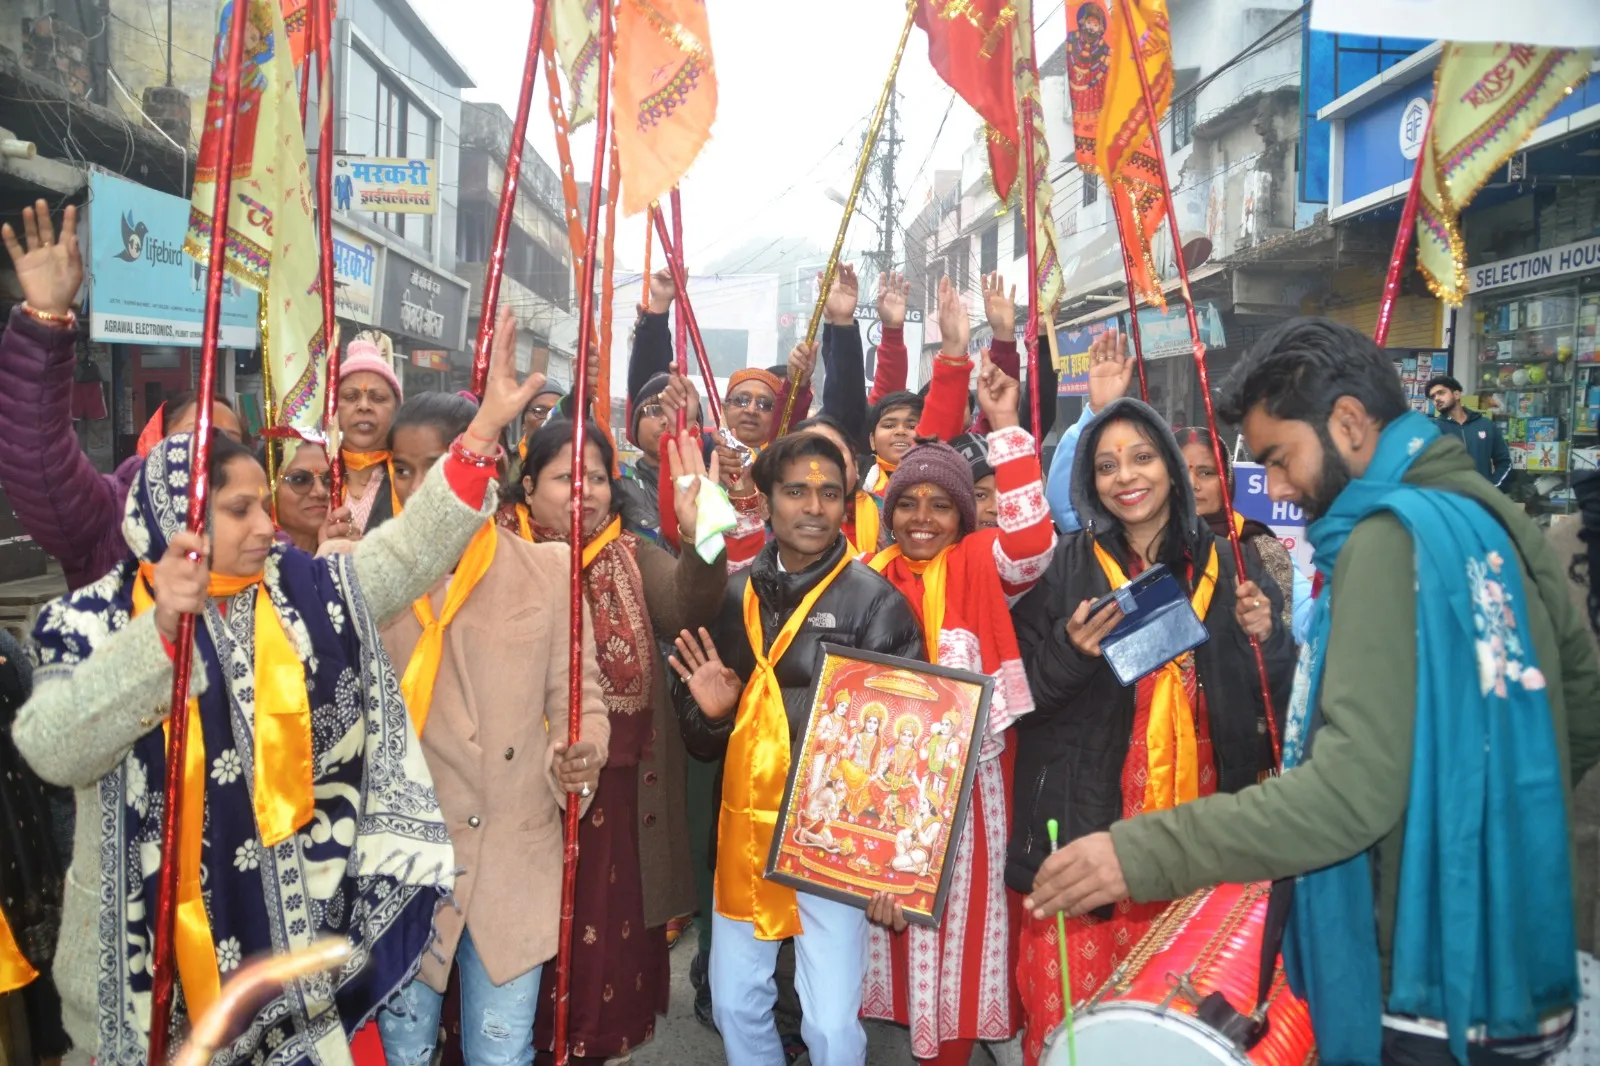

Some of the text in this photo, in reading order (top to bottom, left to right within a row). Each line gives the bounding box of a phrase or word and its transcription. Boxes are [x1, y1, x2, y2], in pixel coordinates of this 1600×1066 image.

[350, 160, 431, 186] मरकरी
[146, 236, 183, 267] lifebird
[1476, 254, 1552, 288] SELECTION
[104, 319, 134, 335] AGRAWAL
[135, 325, 175, 339] ELECTRONICS,
